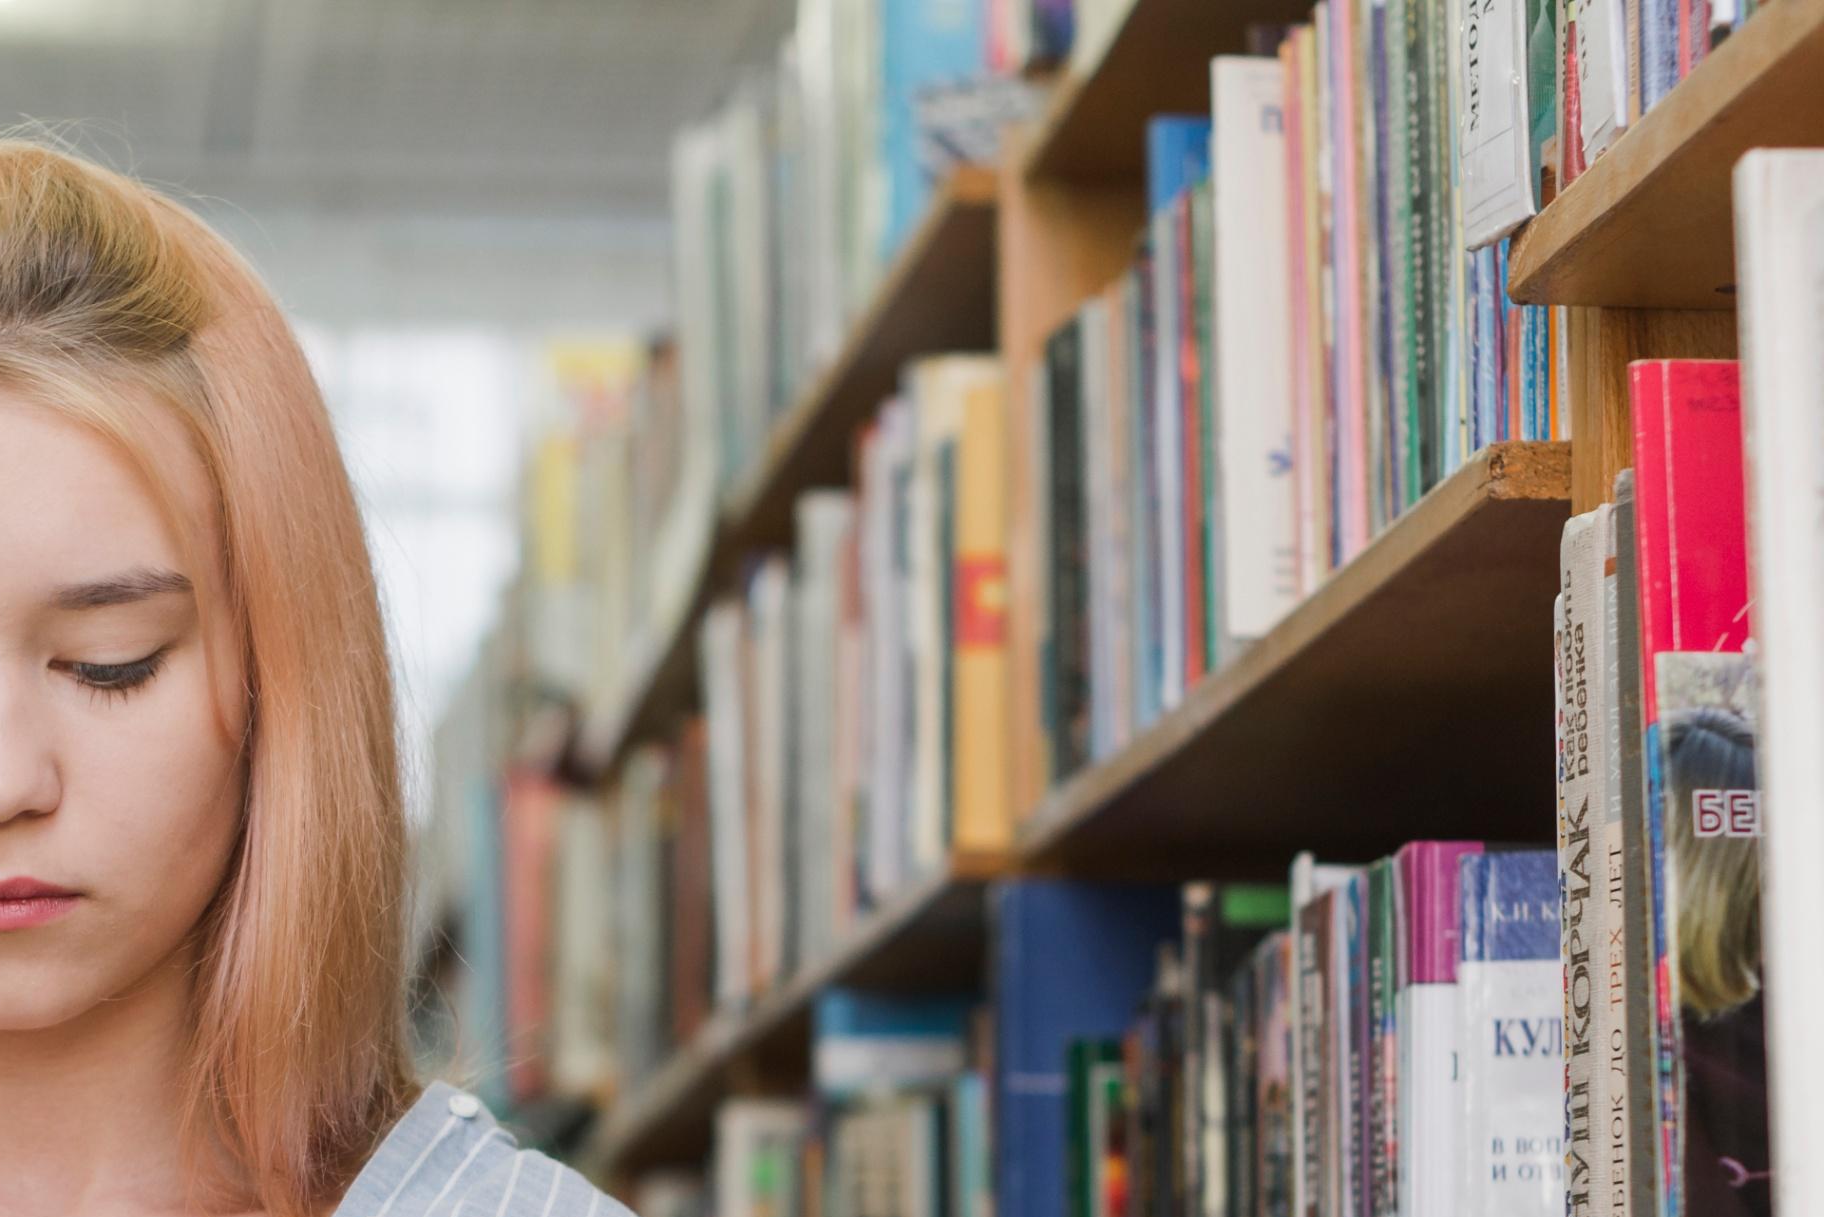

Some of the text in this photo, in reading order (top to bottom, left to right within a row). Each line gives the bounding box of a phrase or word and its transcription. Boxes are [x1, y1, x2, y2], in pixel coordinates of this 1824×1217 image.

[1574, 621, 1589, 777] ребенка
[1692, 789, 1762, 838] БЕ
[1609, 843, 1623, 908] ЛЕТ
[1567, 793, 1591, 1057] КОРЧАК
[1609, 927, 1624, 1012] ТРЕХ
[1610, 1027, 1626, 1076] ДО
